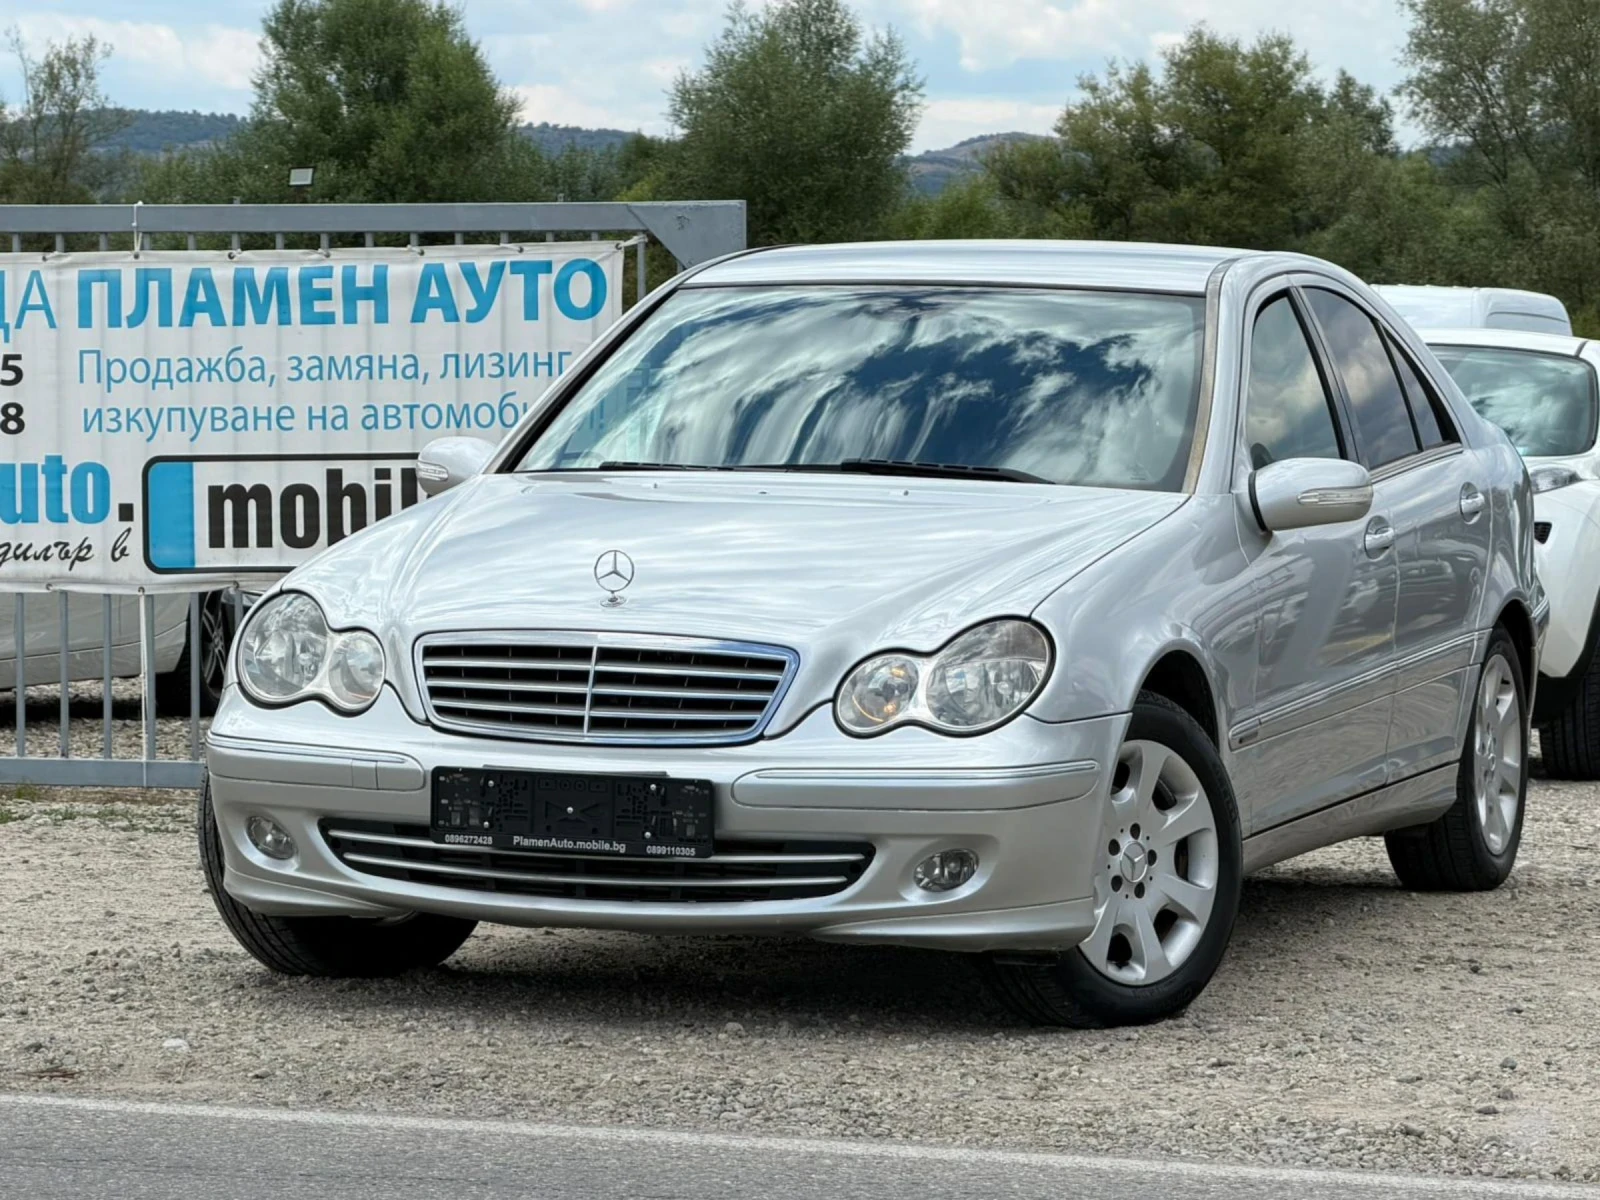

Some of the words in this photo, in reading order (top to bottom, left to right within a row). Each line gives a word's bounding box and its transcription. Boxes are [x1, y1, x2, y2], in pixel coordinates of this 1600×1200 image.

[0, 270, 57, 343] А
[77, 264, 389, 329] ПЛАМЕН
[410, 258, 608, 323] АУТО
[0, 354, 24, 386] 5
[79, 346, 276, 393] Продажба,
[287, 353, 430, 387] замяна,
[439, 351, 572, 379] лизинг
[0, 402, 26, 435] 8
[83, 404, 296, 443] изкупуване
[307, 404, 349, 431] на
[513, 835, 626, 853] PlamenAuto.mobile.bg
